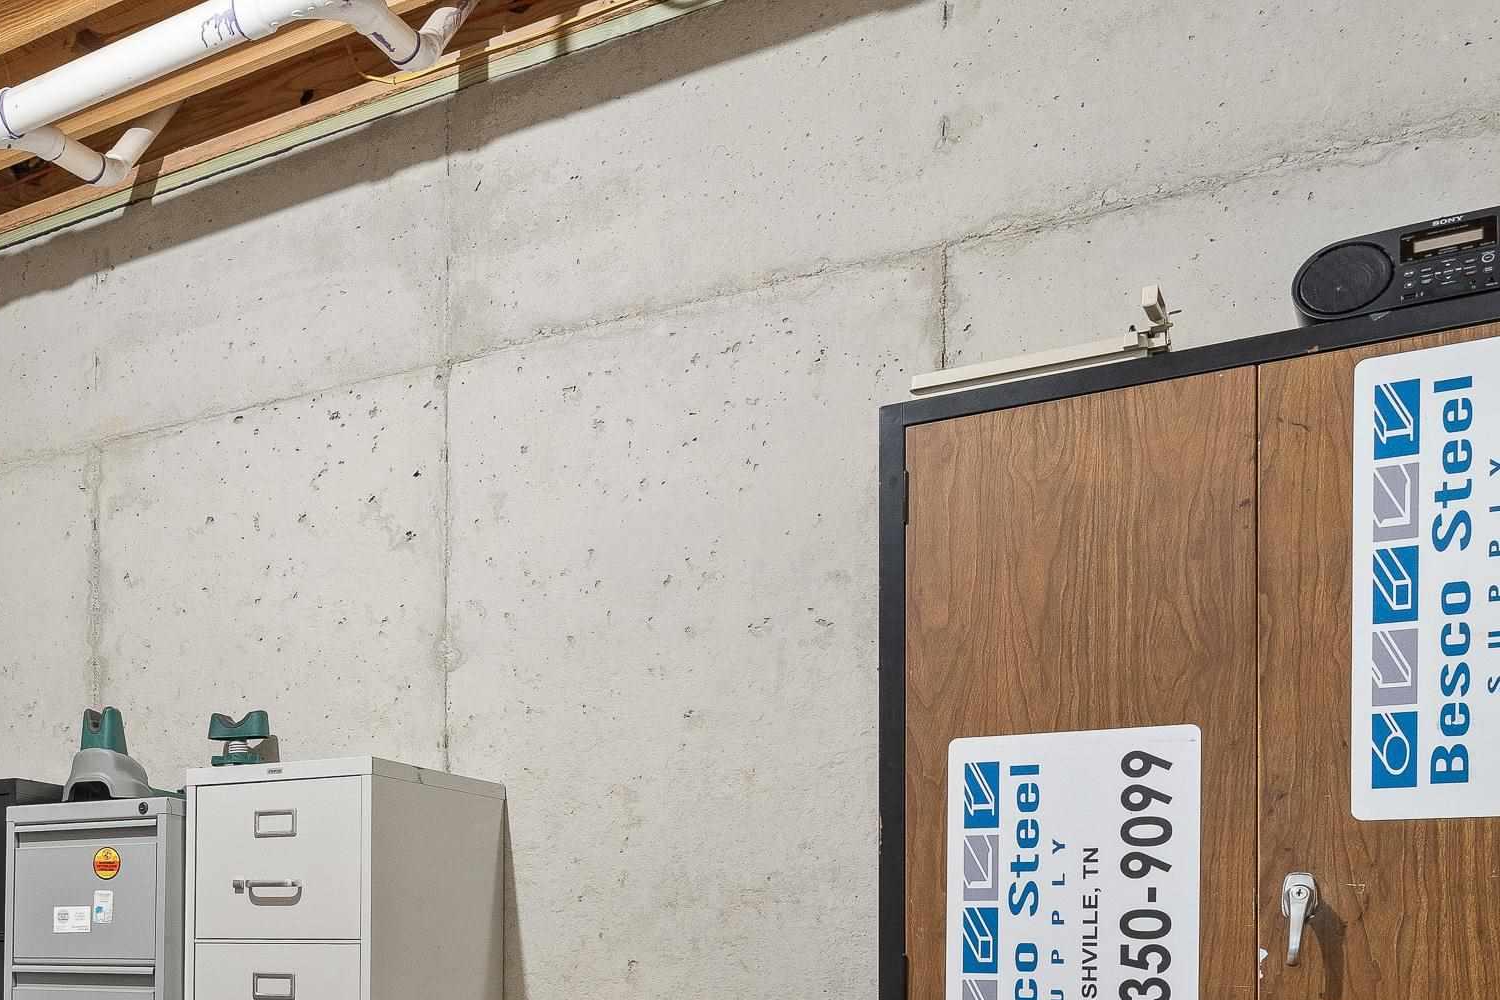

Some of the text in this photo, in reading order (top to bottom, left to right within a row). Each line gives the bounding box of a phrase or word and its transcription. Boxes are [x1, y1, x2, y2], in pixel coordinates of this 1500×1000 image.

[1431, 216, 1463, 227] SONY
[1430, 375, 1473, 785] Besco Steel
[1008, 764, 1041, 917] Steel
[1082, 847, 1100, 880] TN
